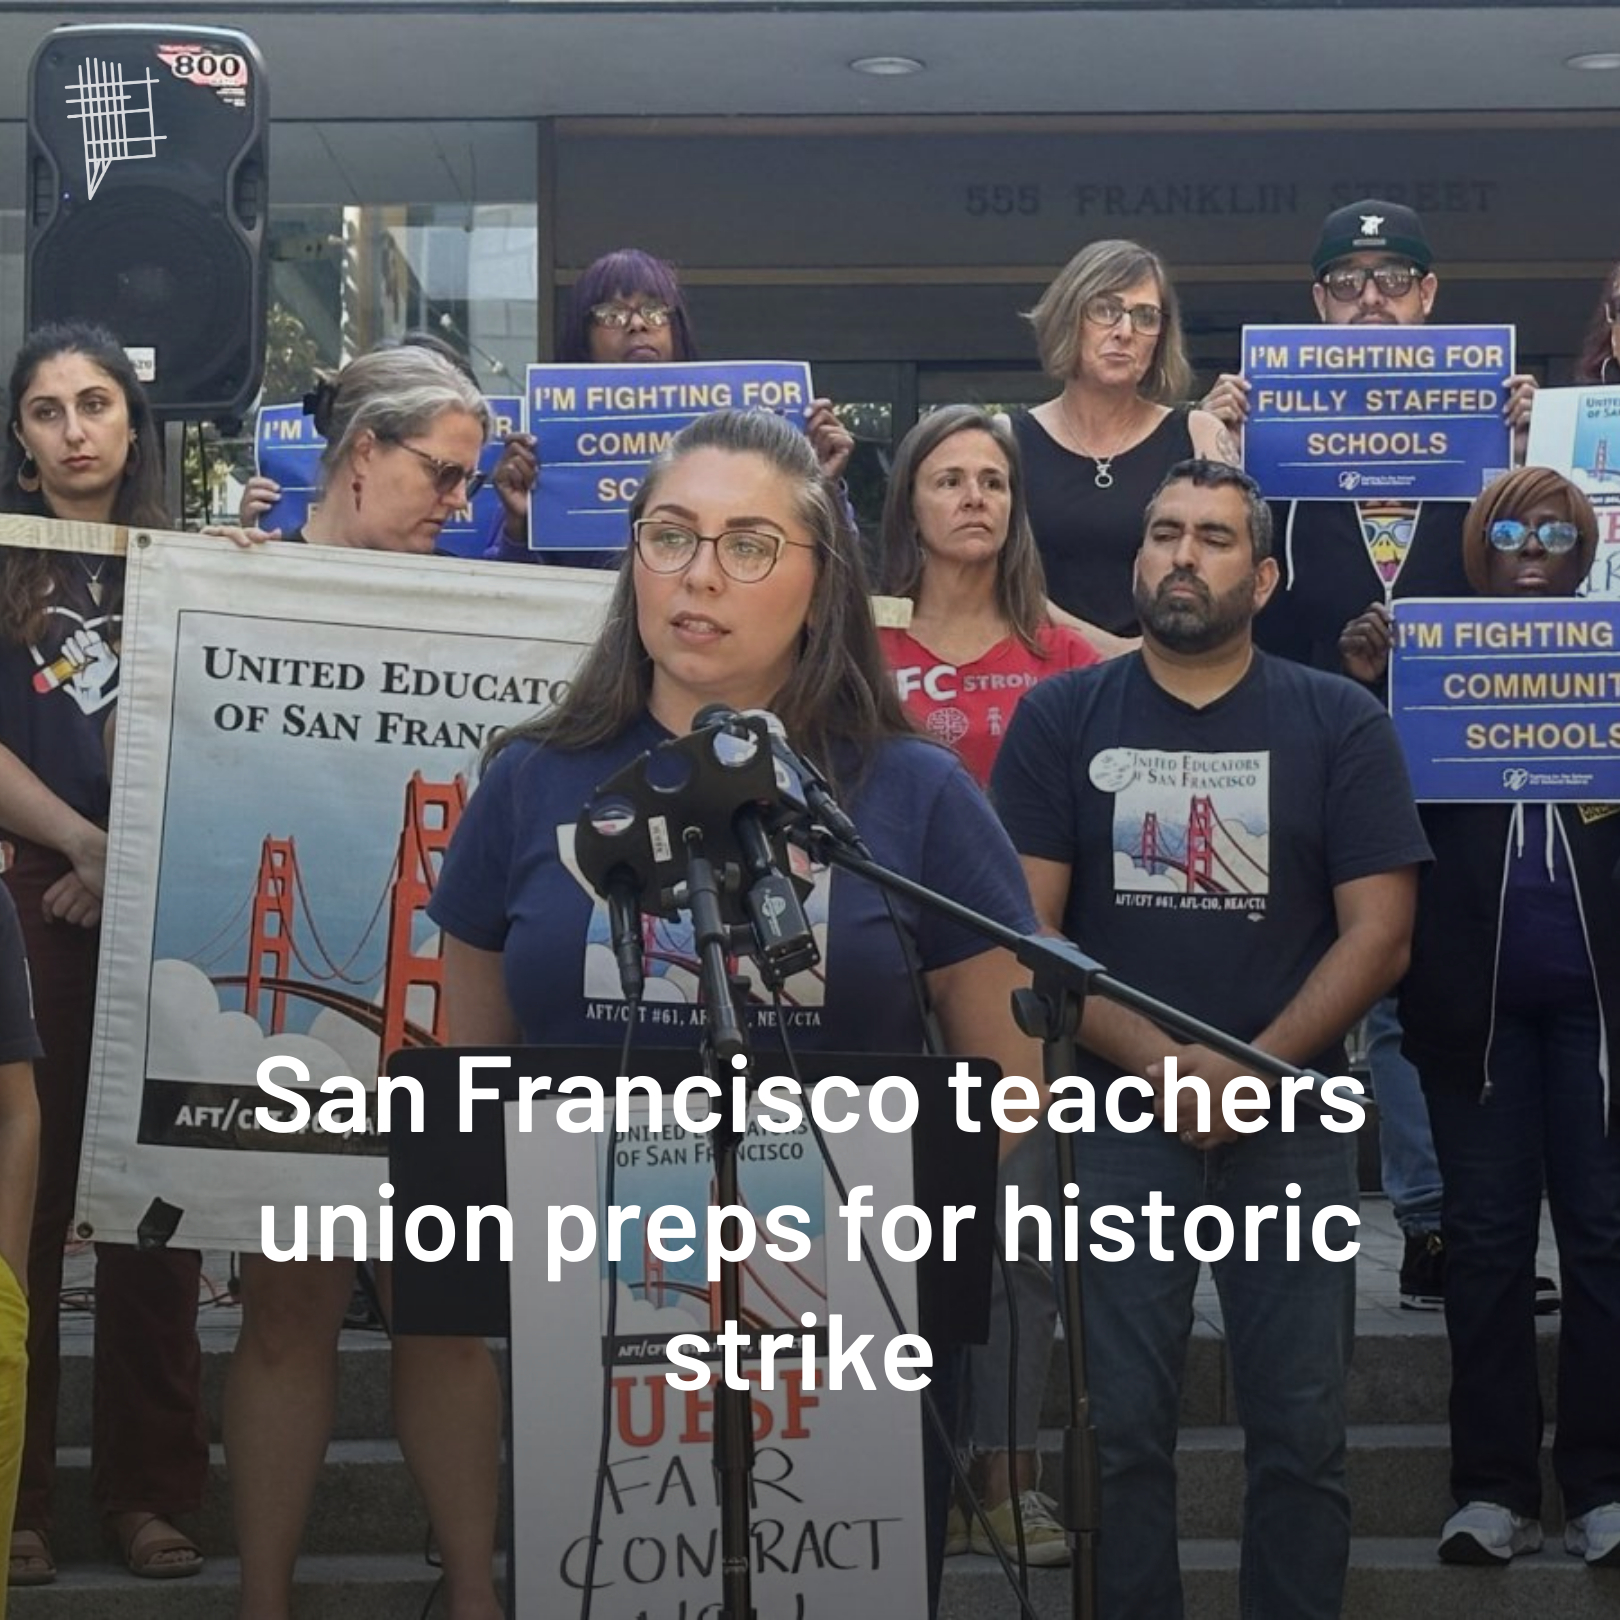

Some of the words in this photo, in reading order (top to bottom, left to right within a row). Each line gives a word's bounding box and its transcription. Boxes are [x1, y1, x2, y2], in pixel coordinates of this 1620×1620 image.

[174, 55, 241, 77] 800
[965, 183, 1041, 216] 555
[1076, 181, 1297, 217] FRANKLIN
[1328, 180, 1498, 214] STREET
[1250, 345, 1290, 369] I'M
[1299, 345, 1436, 370] FIGHTING
[1446, 345, 1504, 369] FOR
[534, 386, 576, 411] I'M
[586, 383, 732, 411] FIGHTING
[743, 380, 803, 406] FOR
[1257, 390, 1348, 413] FULLY
[1365, 389, 1498, 412] STAFFED
[263, 418, 302, 441] I'M
[1307, 431, 1449, 456] SCHOOLS
[1399, 622, 1443, 649] I'M
[1455, 621, 1614, 648] FIGHTING
[202, 645, 366, 692] UNITED
[380, 661, 571, 707] EDUCATO
[963, 673, 1038, 693] STRON
[1443, 672, 1620, 700] COMMUNIT
[213, 702, 270, 733] OF
[281, 702, 362, 742] SAN
[1182, 755, 1260, 774] EDUCATORS
[1148, 769, 1176, 787] SAN
[1181, 771, 1257, 789] FRANCISCO
[585, 1003, 647, 1024] AFT/CT
[757, 1010, 822, 1027] NE/CTA
[616, 1150, 641, 1168] OF
[646, 1145, 687, 1166] SAN
[694, 1141, 804, 1165] FRNCISCO
[560, 1517, 903, 1589] CONRACT
